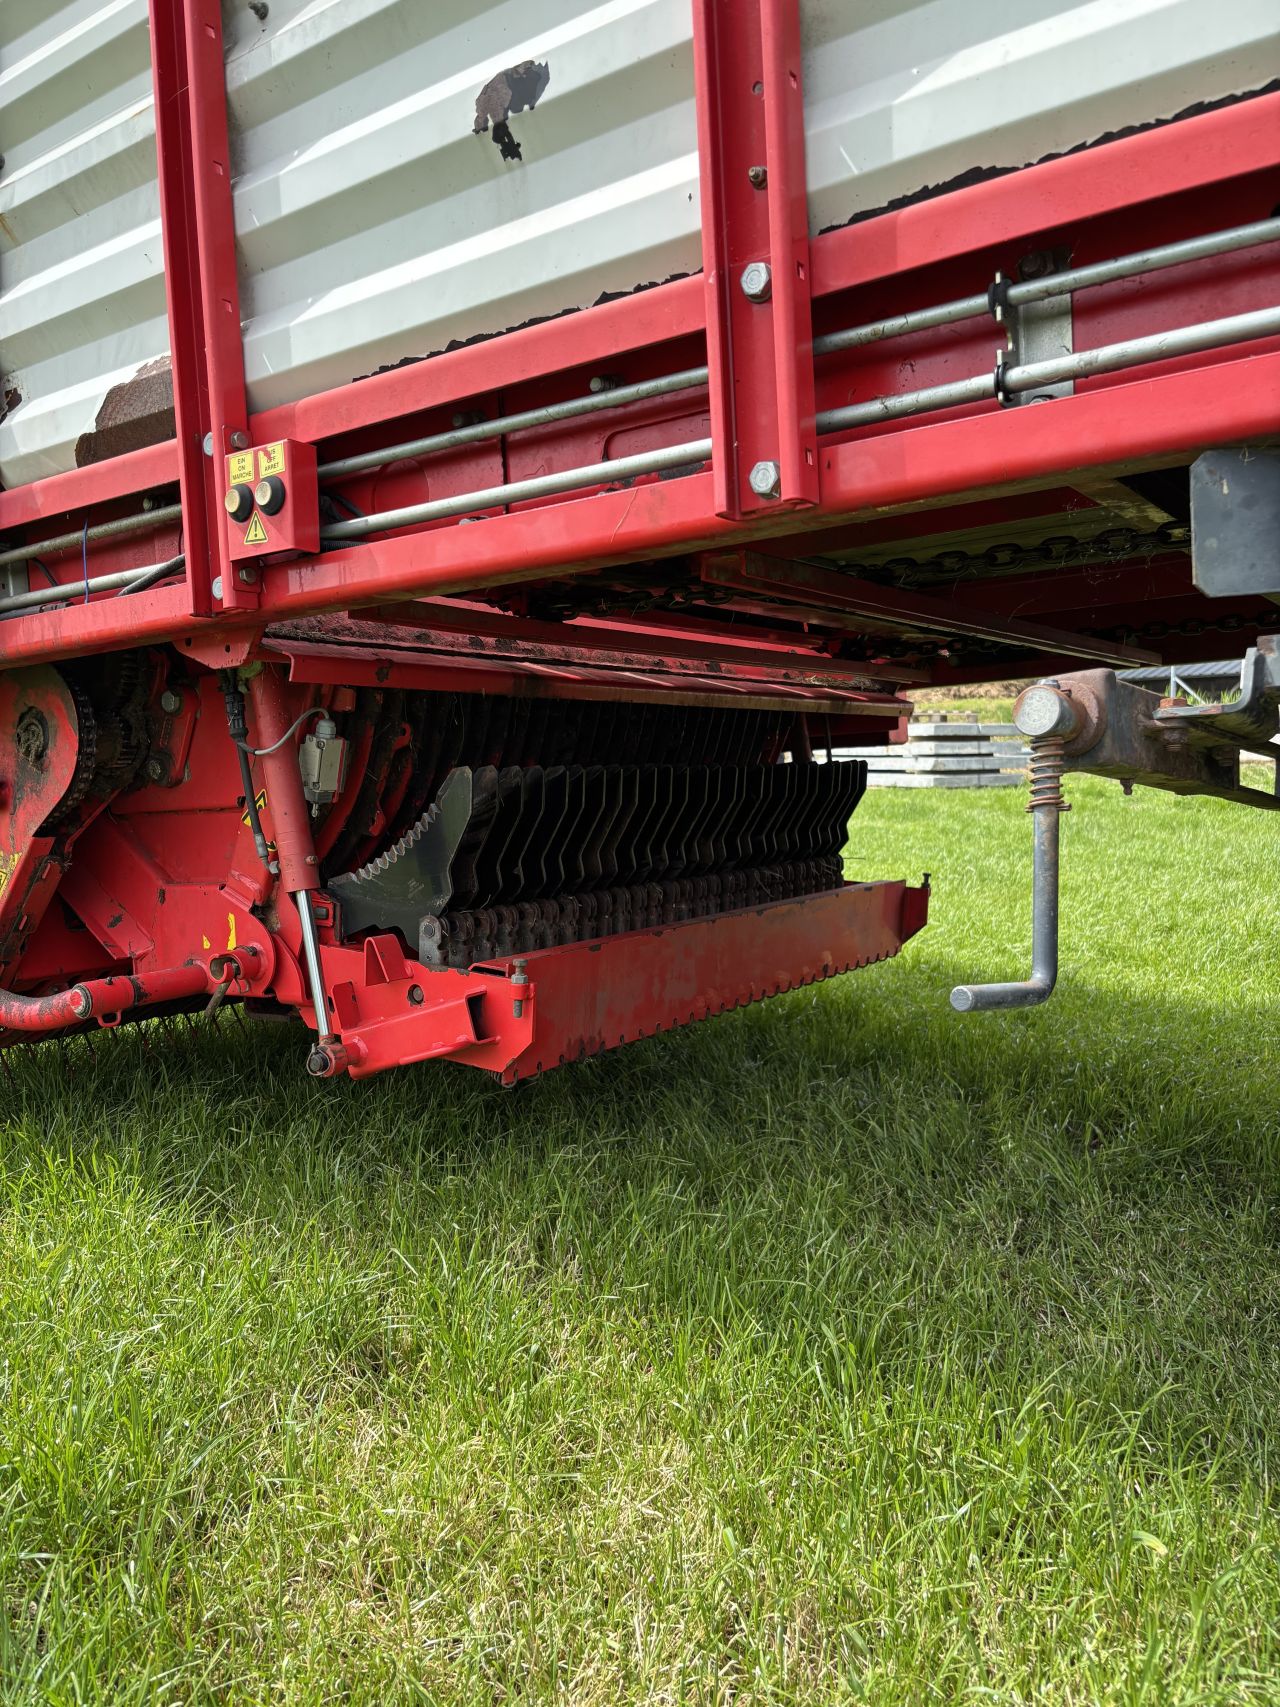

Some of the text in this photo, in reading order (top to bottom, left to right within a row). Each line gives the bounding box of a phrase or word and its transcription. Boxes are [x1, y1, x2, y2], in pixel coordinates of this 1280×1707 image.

[237, 457, 246, 465] EIN
[264, 462, 280, 472] ARRET
[232, 470, 252, 480] MARCHE
